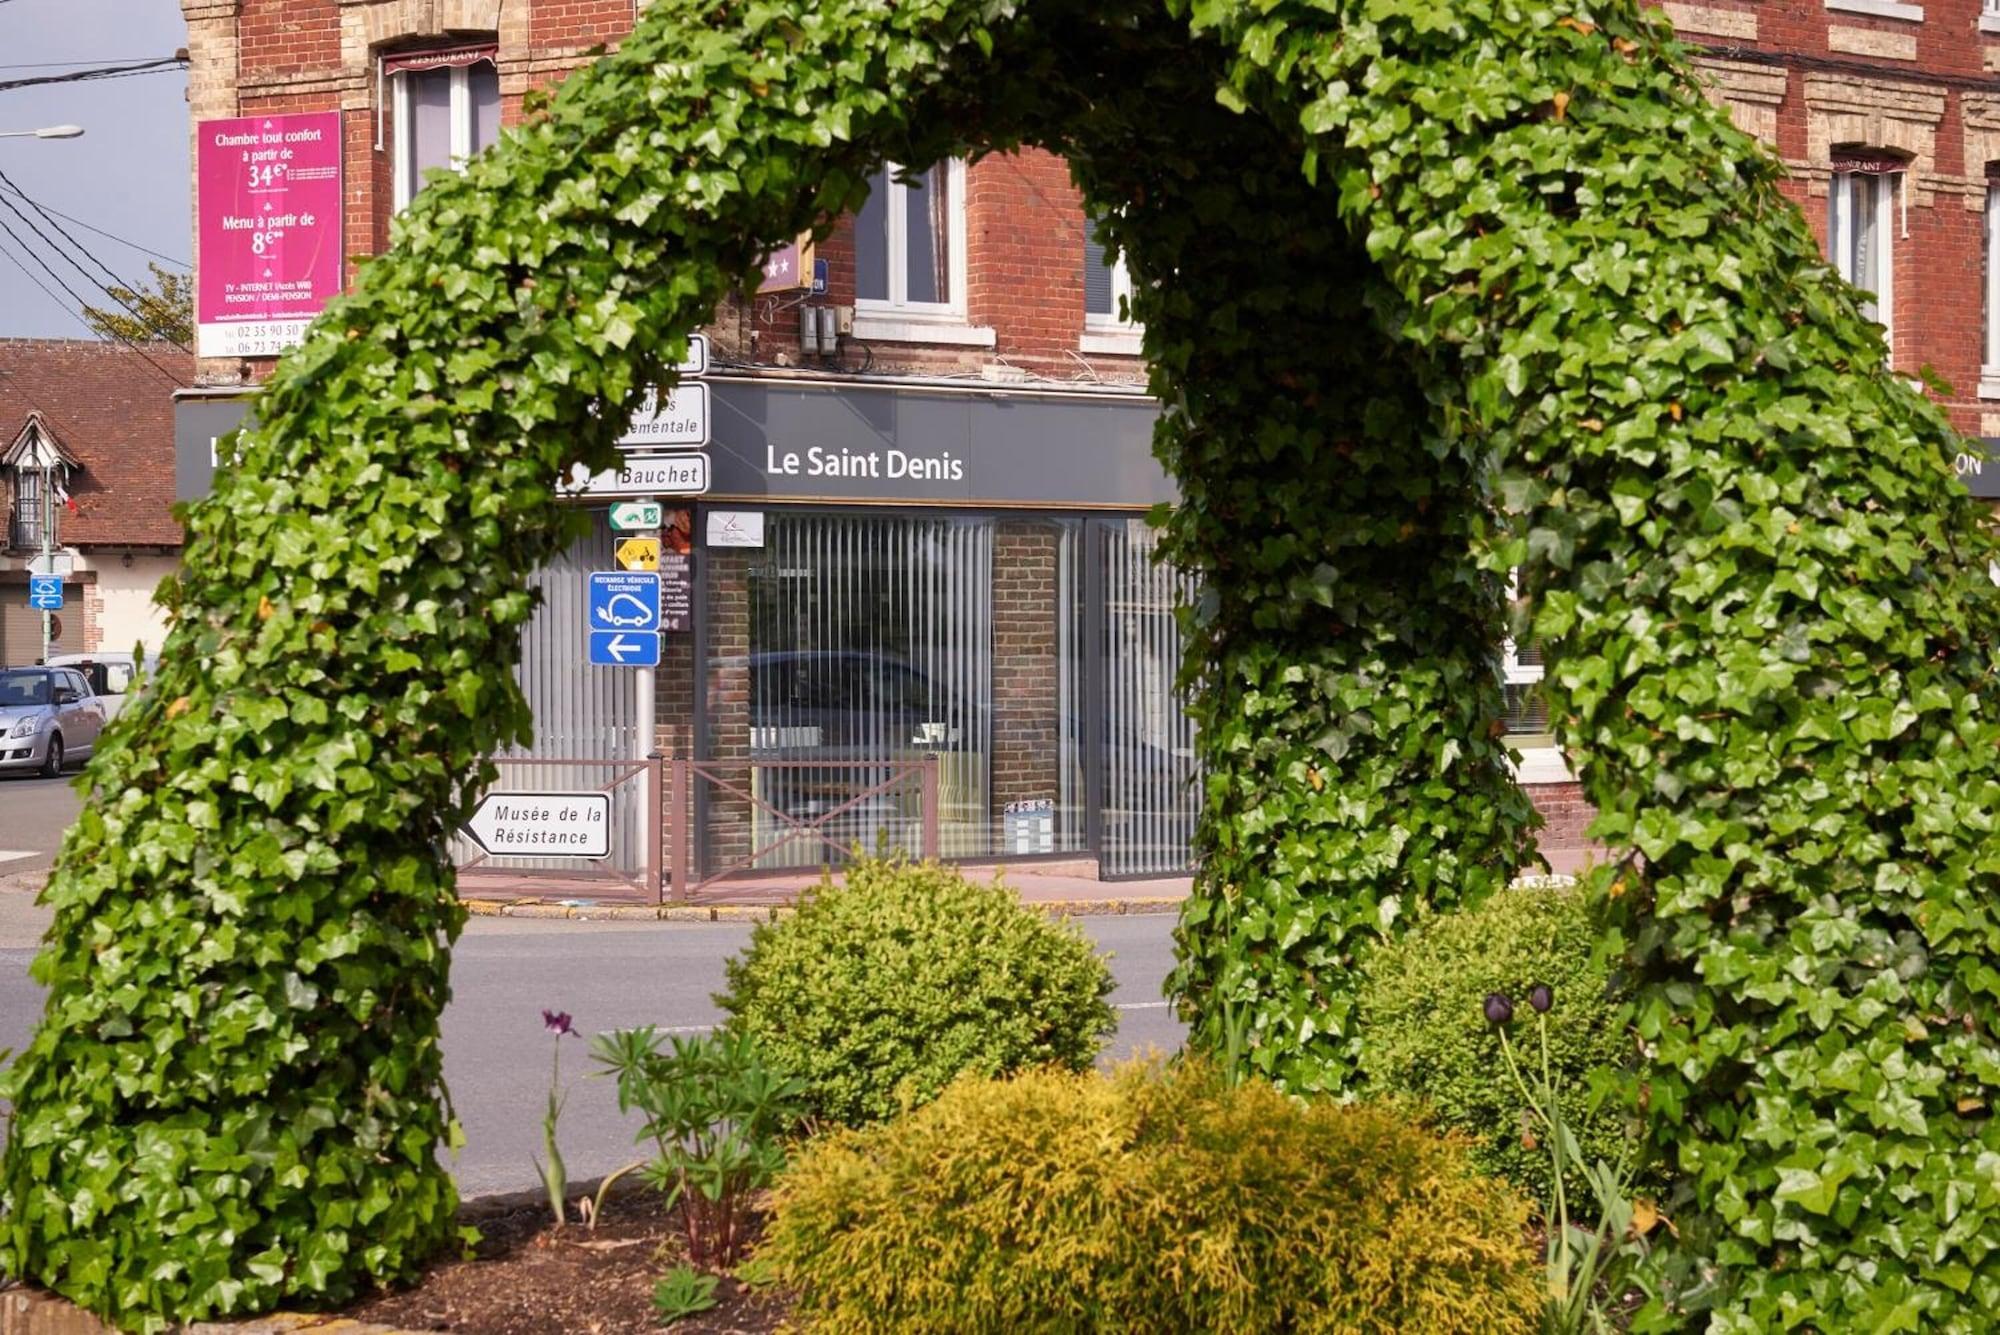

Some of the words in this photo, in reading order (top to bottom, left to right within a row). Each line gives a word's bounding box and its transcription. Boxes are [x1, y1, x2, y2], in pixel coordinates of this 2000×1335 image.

[215, 133, 259, 147] Chambre
[262, 131, 282, 144] tout
[285, 128, 321, 143] confort
[242, 150, 249, 162] à
[252, 148, 278, 164] partir
[280, 147, 293, 160] de
[223, 215, 254, 230] Menu
[257, 215, 264, 228] à
[268, 213, 297, 231] partir
[300, 212, 315, 226] de
[631, 419, 697, 433] ementale
[767, 445, 800, 475] Le
[808, 446, 880, 478] Saint
[887, 450, 964, 480] Denis
[1955, 453, 1981, 475] ON
[621, 465, 698, 484] Bauchet
[494, 805, 550, 822] Musée
[559, 805, 578, 822] de
[587, 806, 601, 822] la
[494, 828, 588, 844] Résistance
